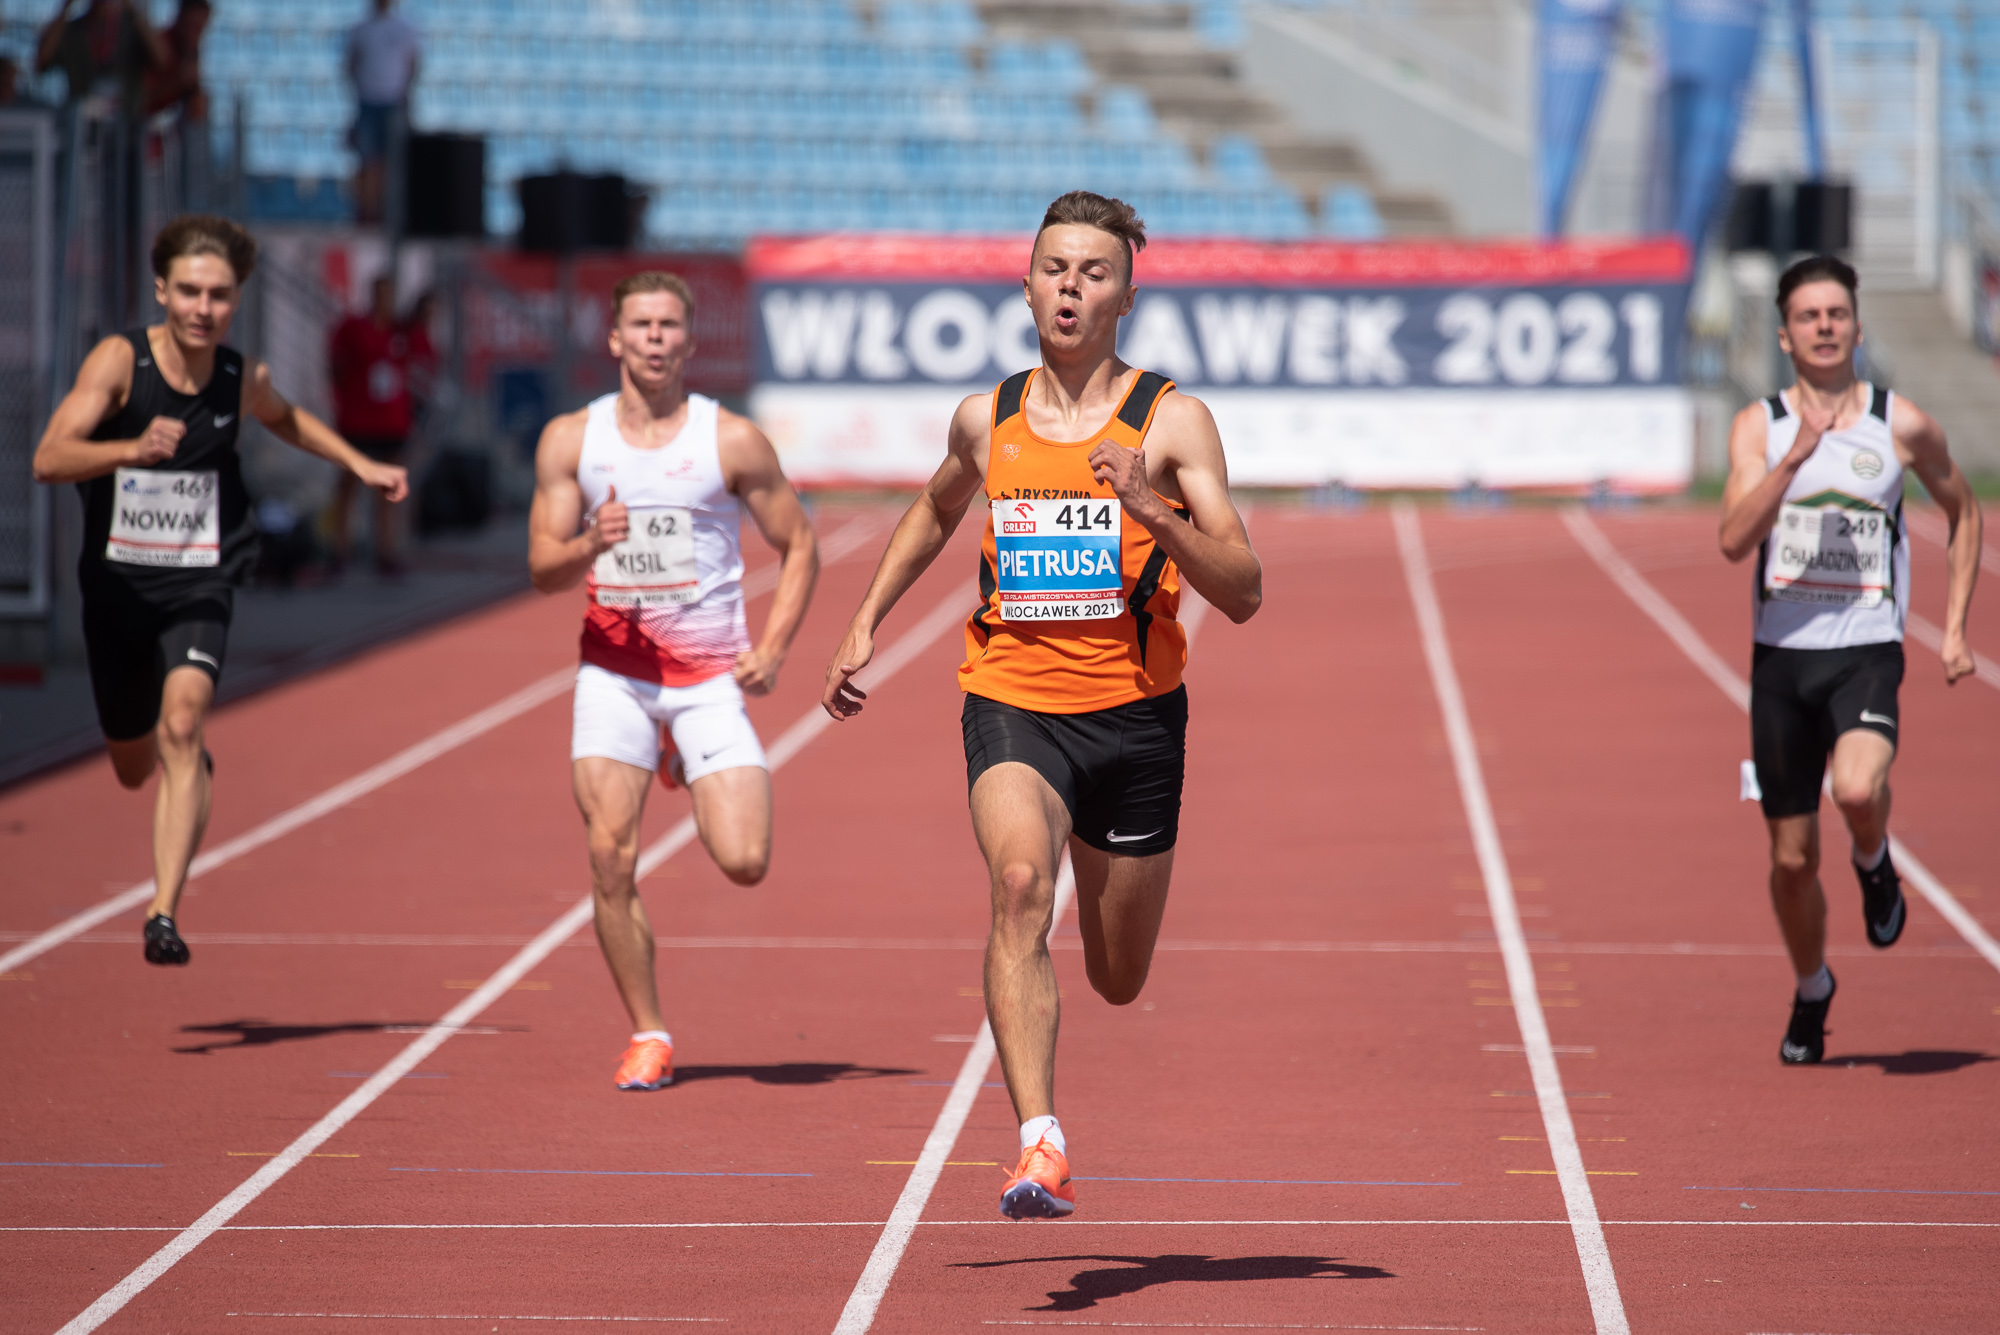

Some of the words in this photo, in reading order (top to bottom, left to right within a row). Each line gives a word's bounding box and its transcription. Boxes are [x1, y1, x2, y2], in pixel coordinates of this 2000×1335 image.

[763, 288, 1408, 384] WŁOCAWEK
[1433, 291, 1664, 385] 2021
[172, 474, 213, 499] 469
[121, 507, 207, 531] NOWAK
[648, 515, 677, 537] 62
[1004, 522, 1034, 533] ORLEN
[1056, 505, 1112, 530] 414
[1837, 516, 1879, 538] 249
[615, 551, 667, 575] KISIL
[1000, 549, 1117, 577] PIETRUSA
[1076, 592, 1102, 600] POLSKI
[1004, 605, 1080, 618] WŁOCŁAWEK
[1084, 603, 1115, 617] 2021
